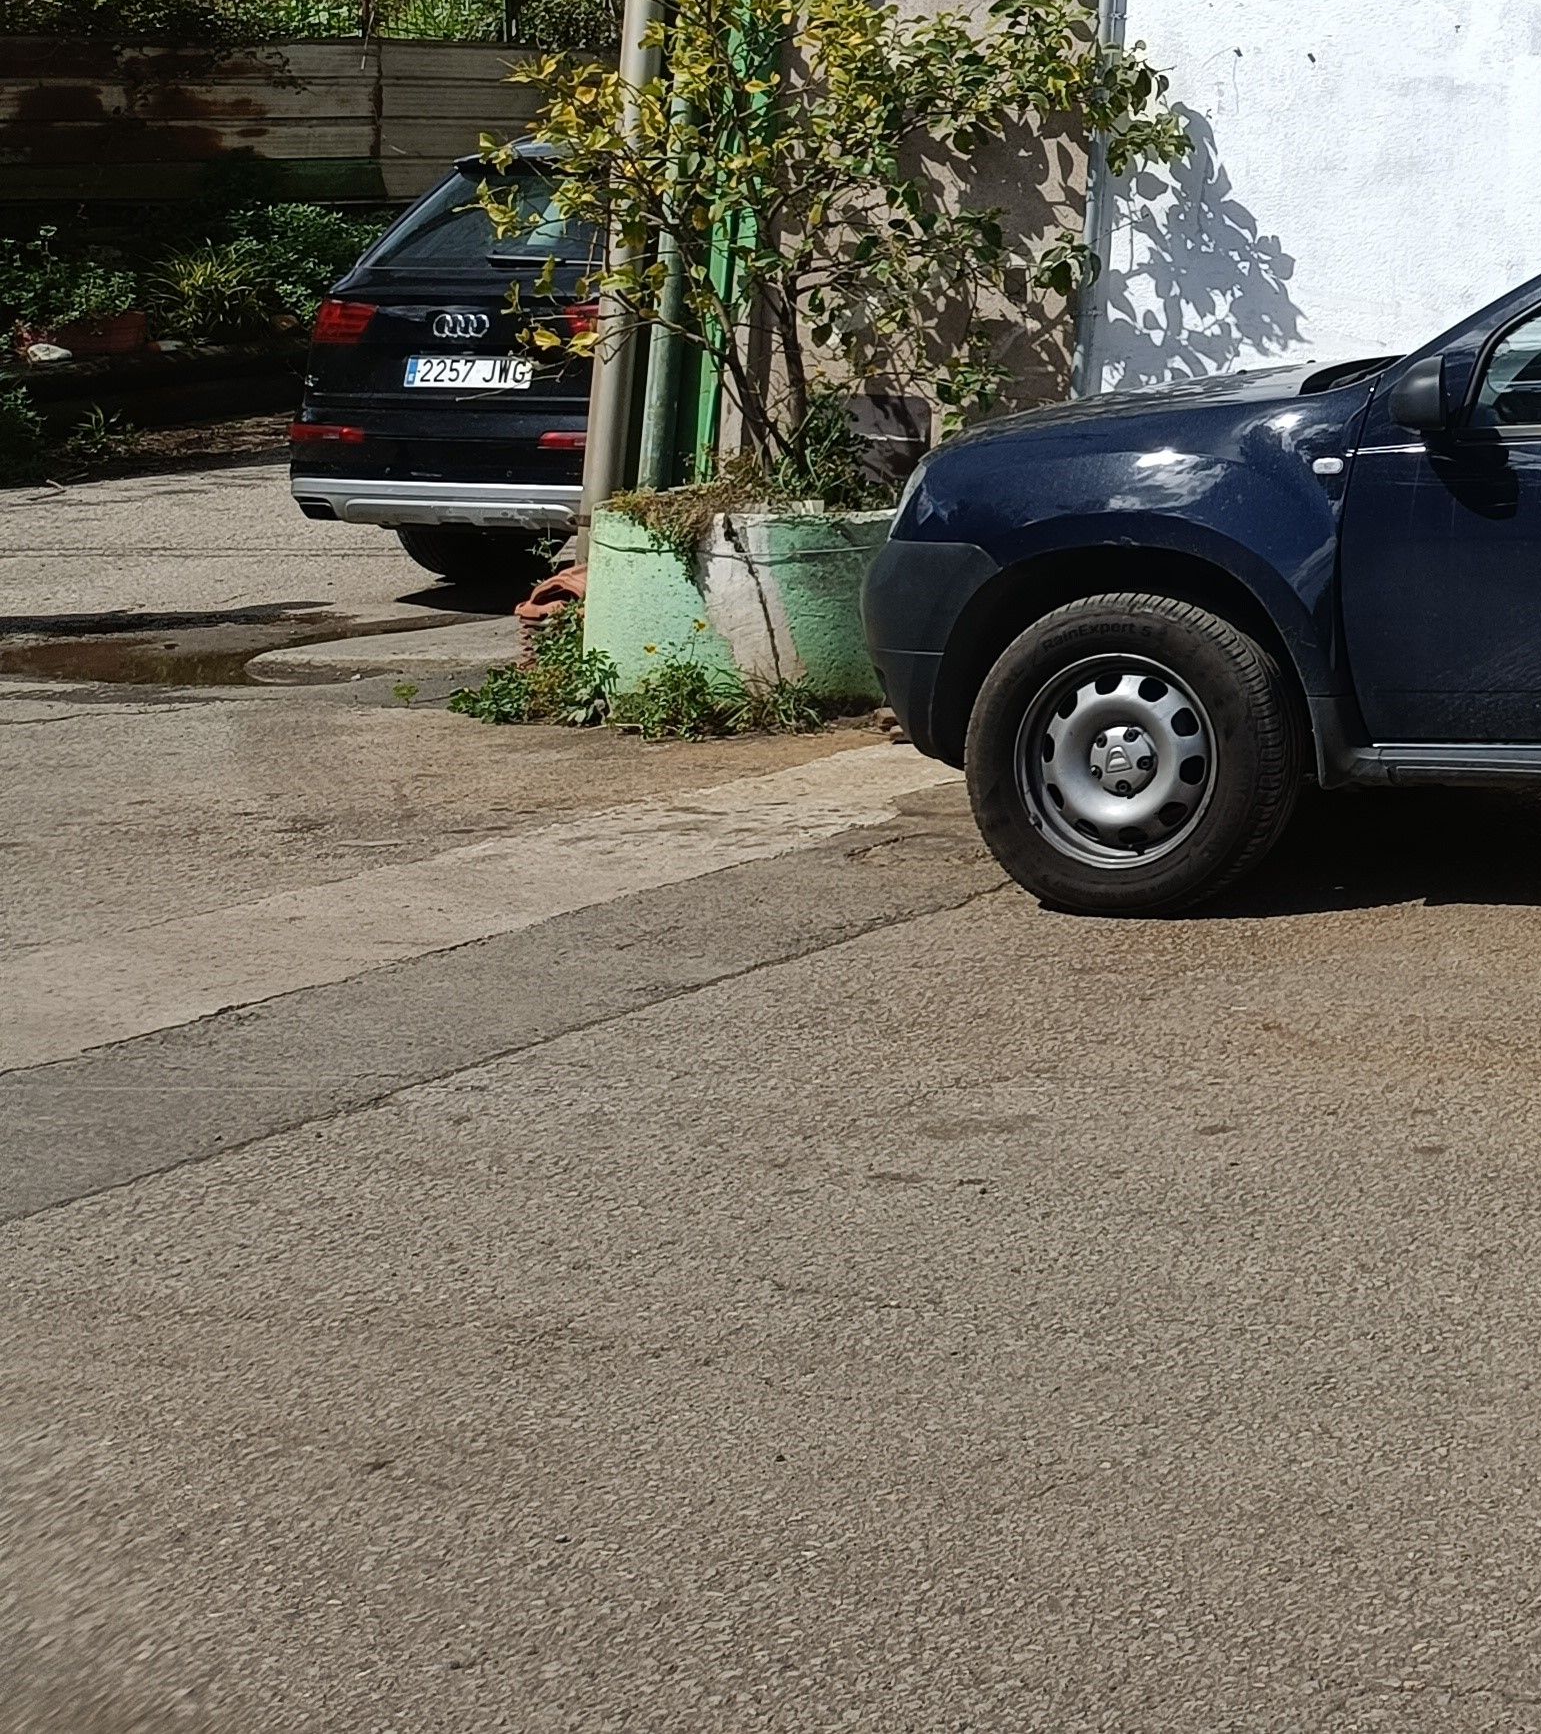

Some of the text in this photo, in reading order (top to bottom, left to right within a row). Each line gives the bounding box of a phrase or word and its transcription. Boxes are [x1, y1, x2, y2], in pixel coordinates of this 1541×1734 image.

[419, 358, 529, 384] 2257 JWG
[1041, 622, 1136, 649] RainExpert
